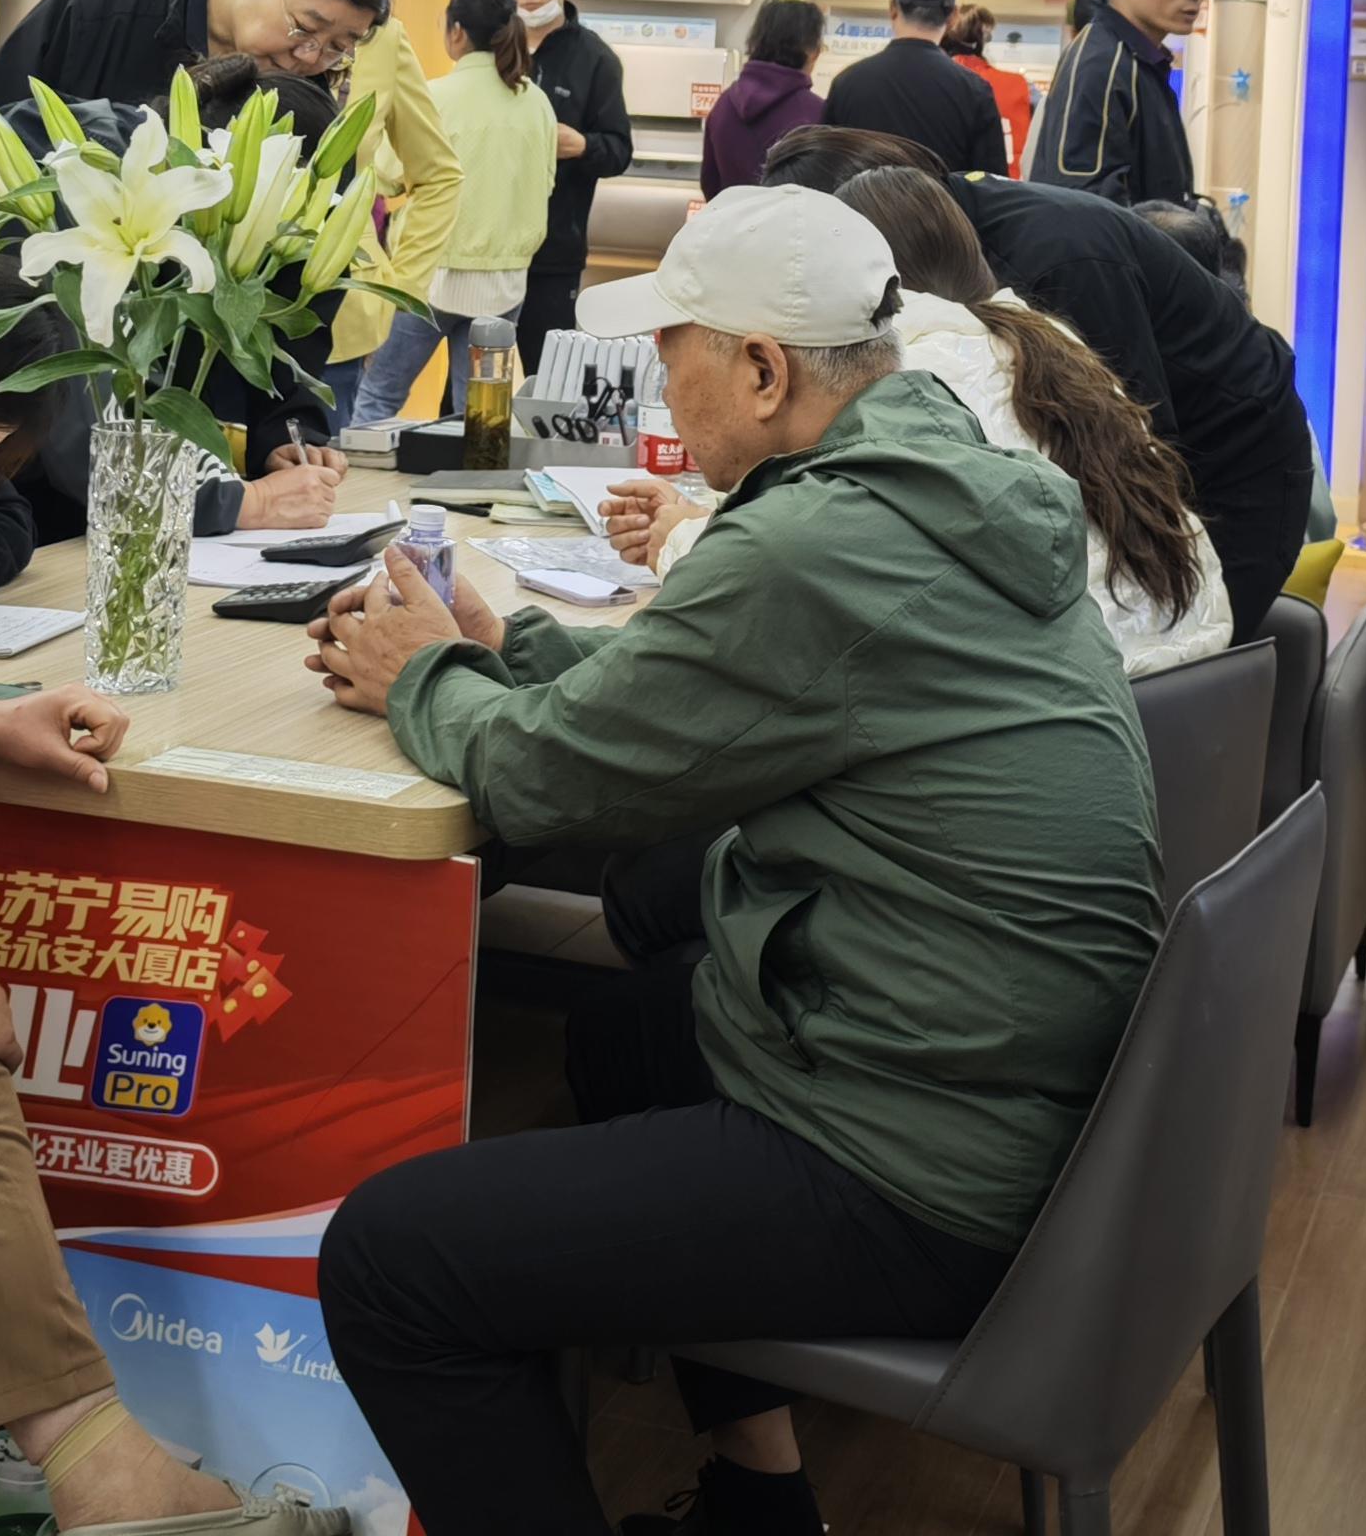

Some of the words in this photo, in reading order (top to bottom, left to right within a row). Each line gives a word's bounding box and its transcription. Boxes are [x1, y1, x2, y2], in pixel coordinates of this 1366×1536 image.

[106, 1041, 187, 1077] Suning
[109, 1073, 173, 1108] Pro
[109, 1300, 223, 1355] Midea
